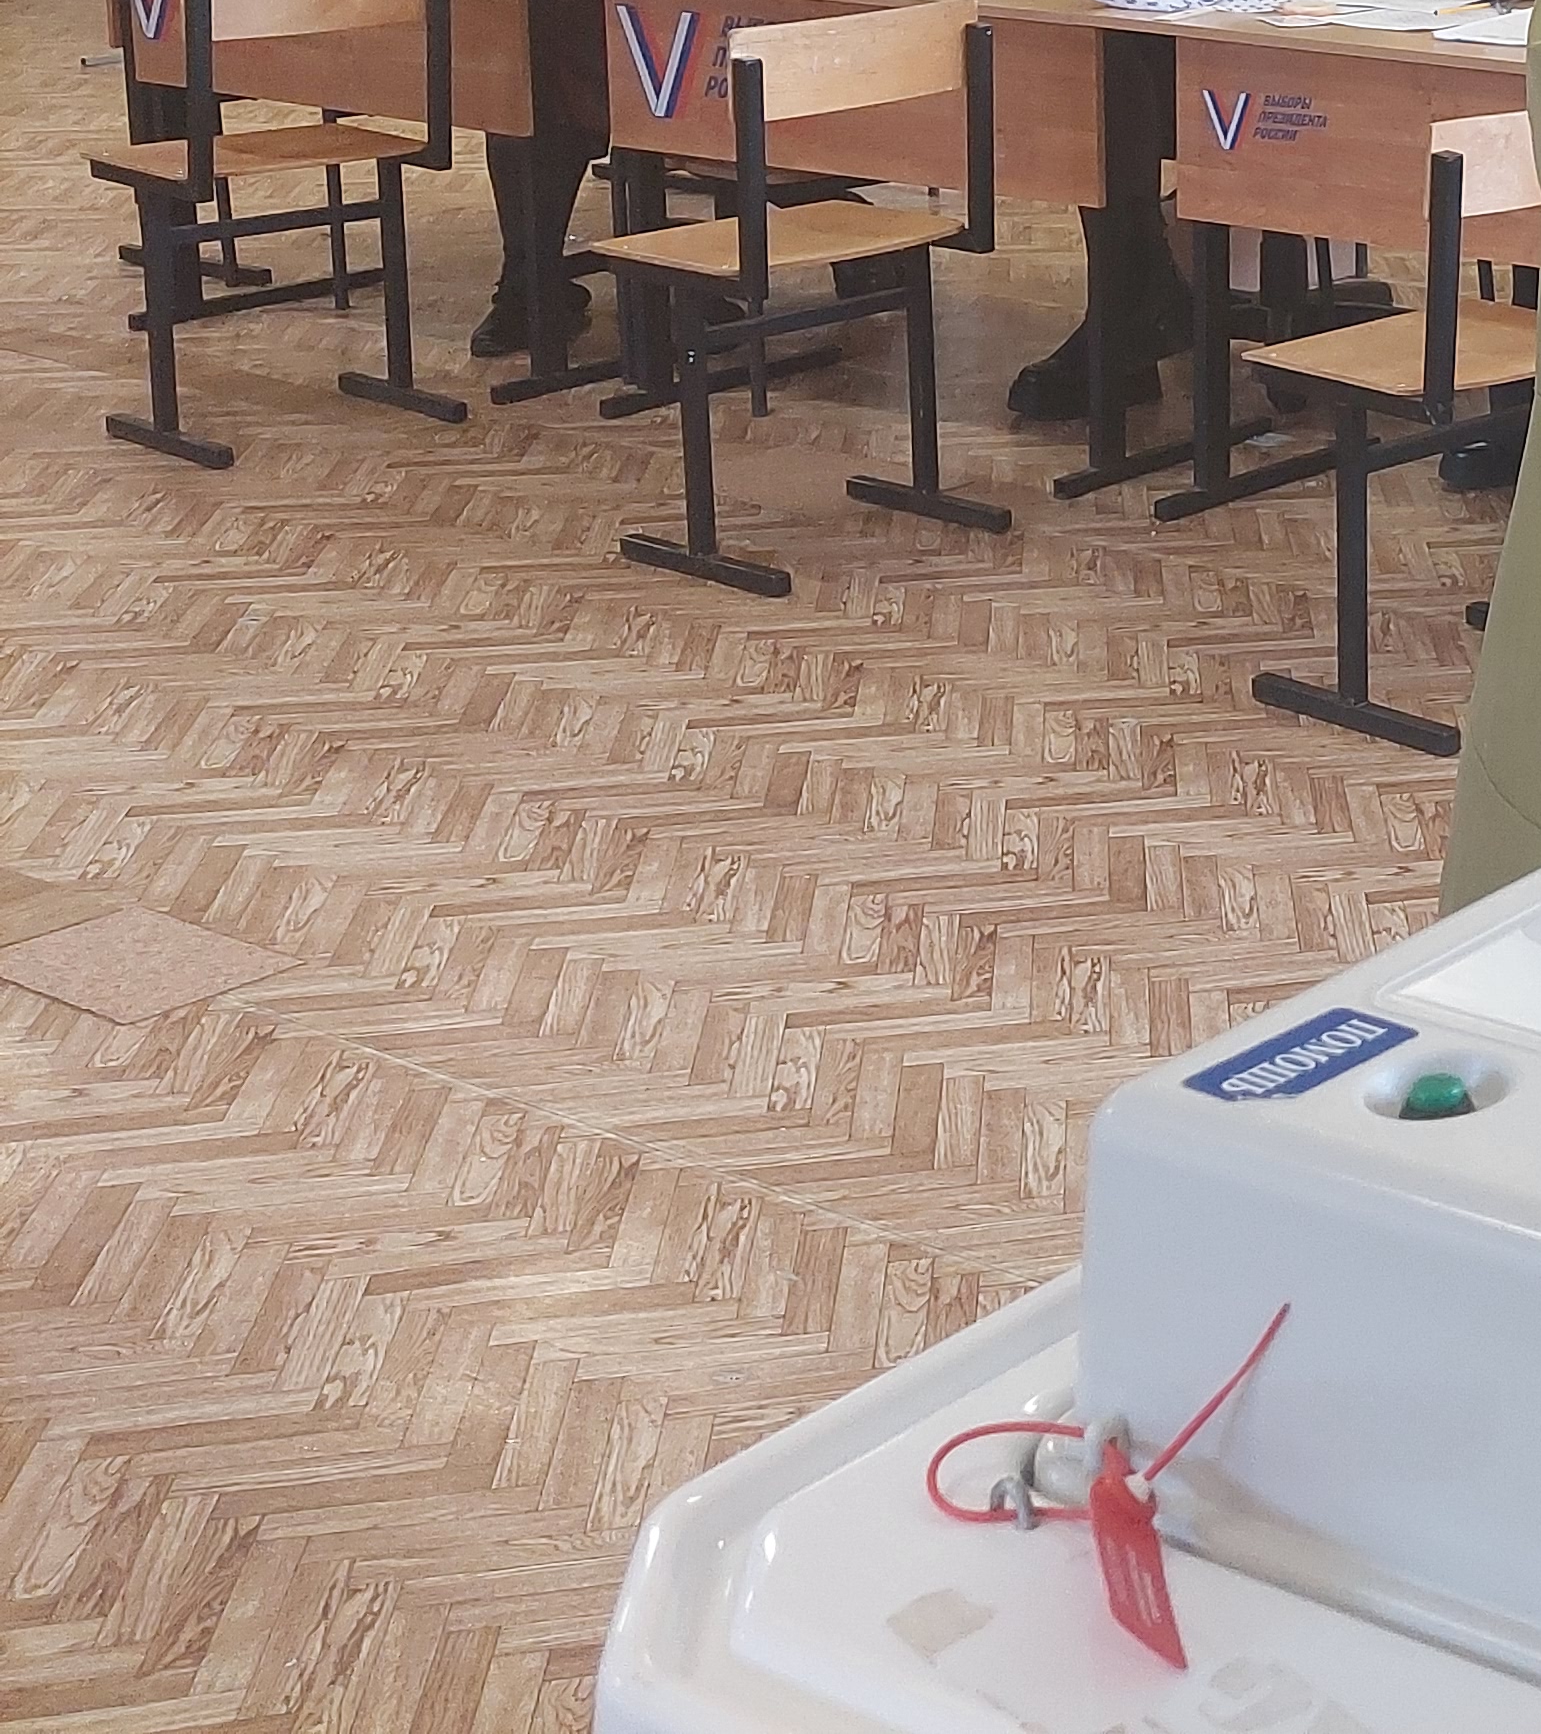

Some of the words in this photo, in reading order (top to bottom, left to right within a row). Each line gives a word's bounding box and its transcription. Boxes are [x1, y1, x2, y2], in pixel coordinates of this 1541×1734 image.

[1262, 94, 1314, 111] ВЫБОРЫ
[1257, 111, 1328, 128] ПРЕЗИДЕНТА
[1220, 1018, 1389, 1095] ПОМОЩЬ
